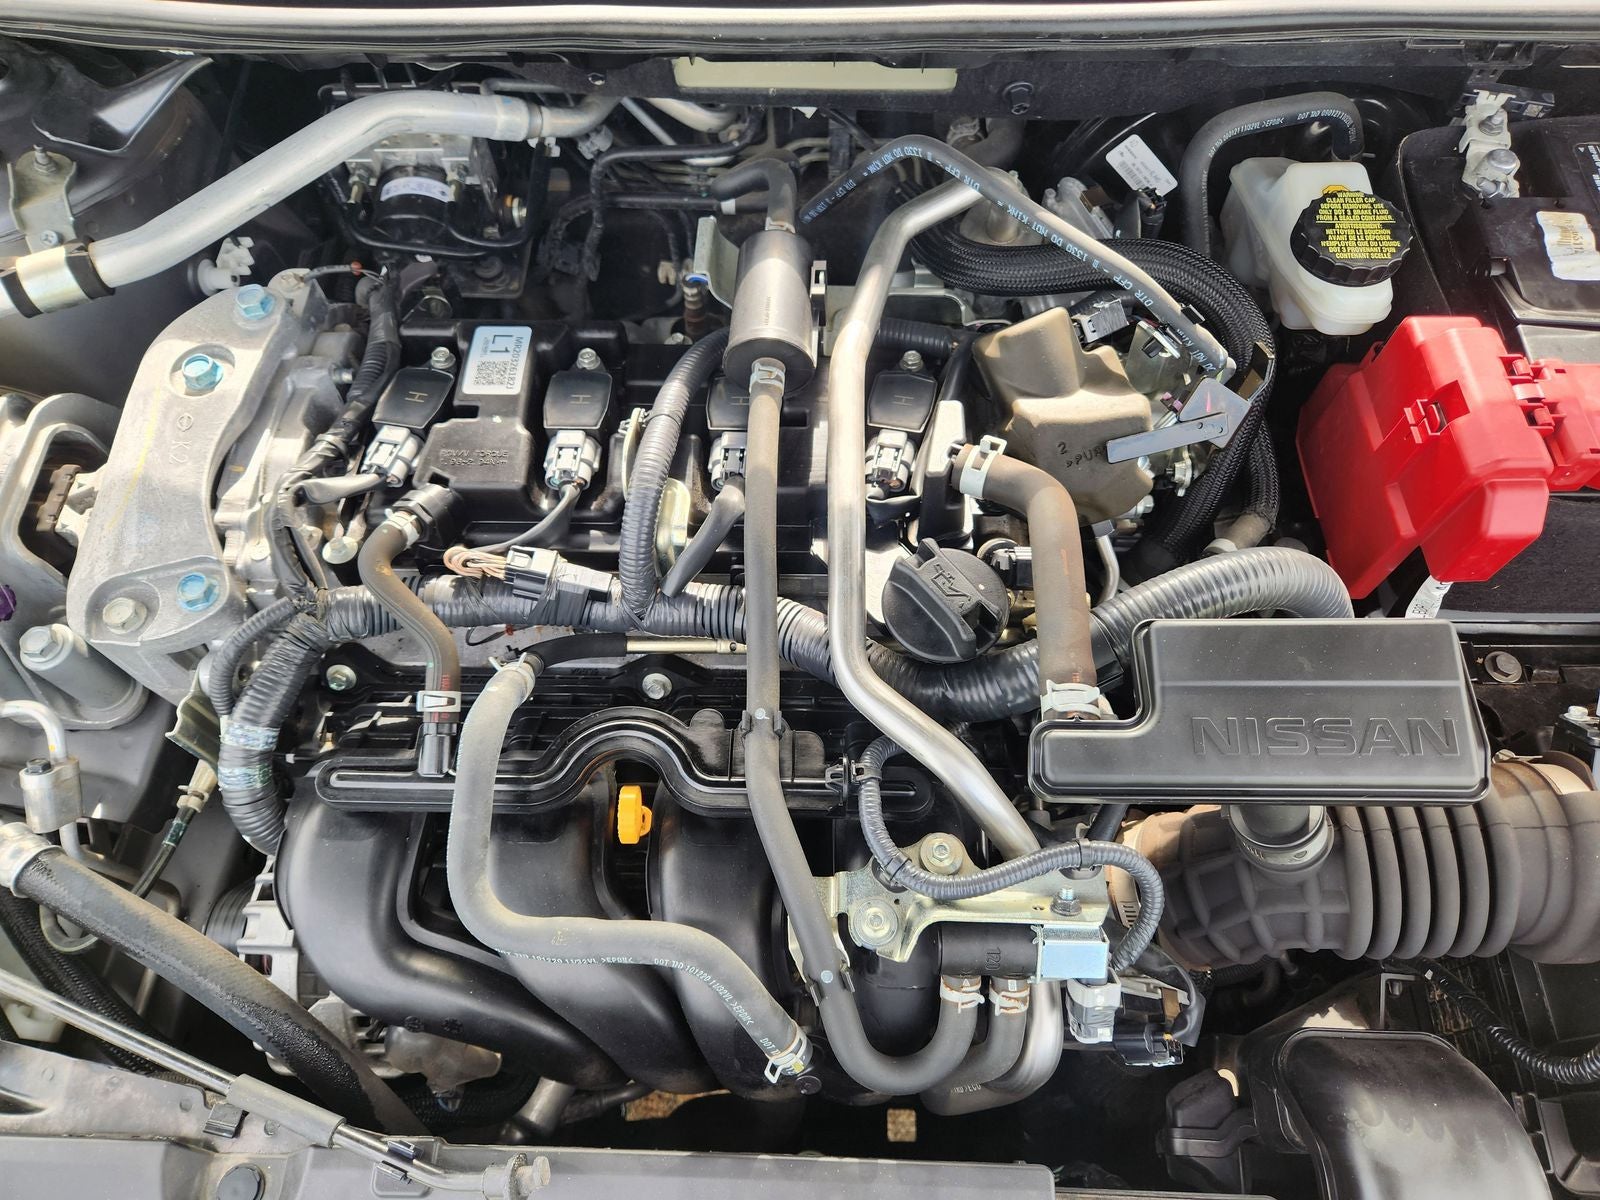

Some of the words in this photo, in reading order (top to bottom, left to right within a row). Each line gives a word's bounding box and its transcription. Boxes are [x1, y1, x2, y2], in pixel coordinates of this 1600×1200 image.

[1006, 204, 1029, 224] KINK
[1031, 221, 1049, 238] NOT
[1050, 234, 1063, 247] DO
[1065, 243, 1089, 262] 1330
[1113, 274, 1133, 290] CFP
[1134, 289, 1154, 307] DTR
[490, 334, 513, 354] L1
[1192, 717, 1460, 756] NISSAN
[654, 958, 670, 966] DOT
[685, 965, 711, 982] 101220
[760, 1037, 775, 1053] DOT
